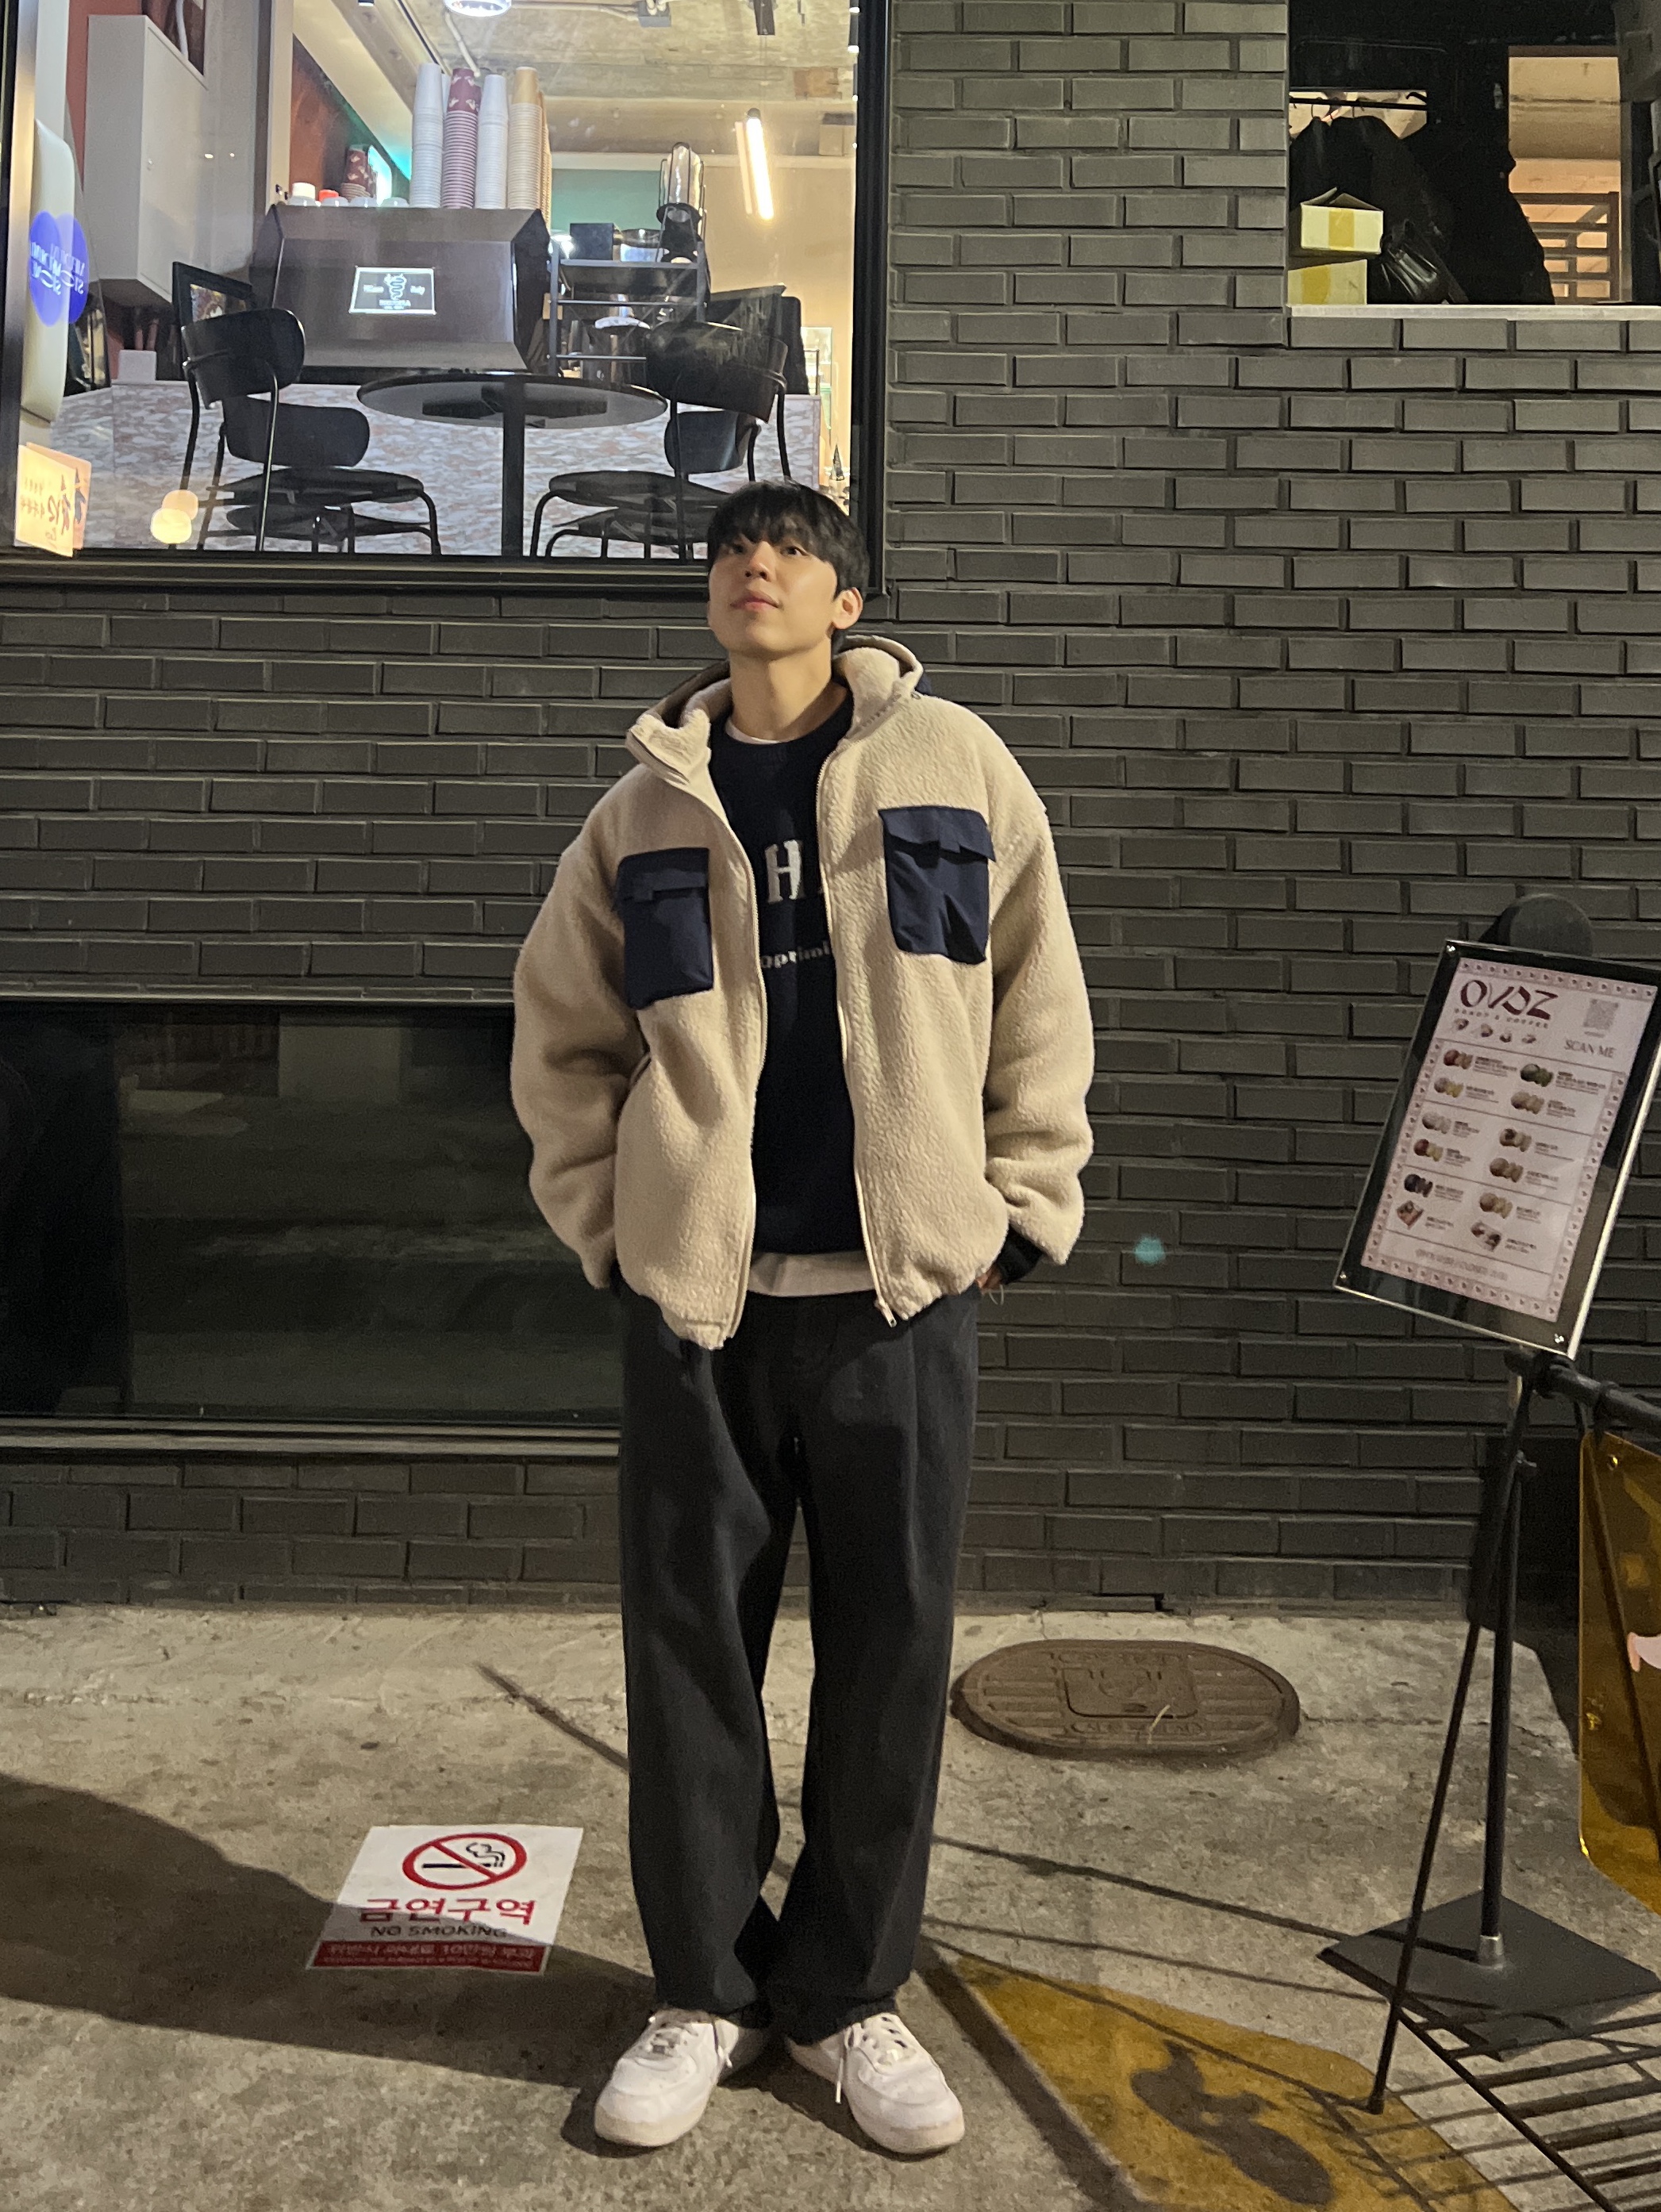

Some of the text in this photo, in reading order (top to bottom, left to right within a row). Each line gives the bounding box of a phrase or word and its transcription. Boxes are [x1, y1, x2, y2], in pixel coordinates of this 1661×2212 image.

[1563, 1039, 1617, 1059] SCAN ME
[359, 1897, 536, 1926] 금연구역
[369, 1924, 509, 1938] NO SMOKING
